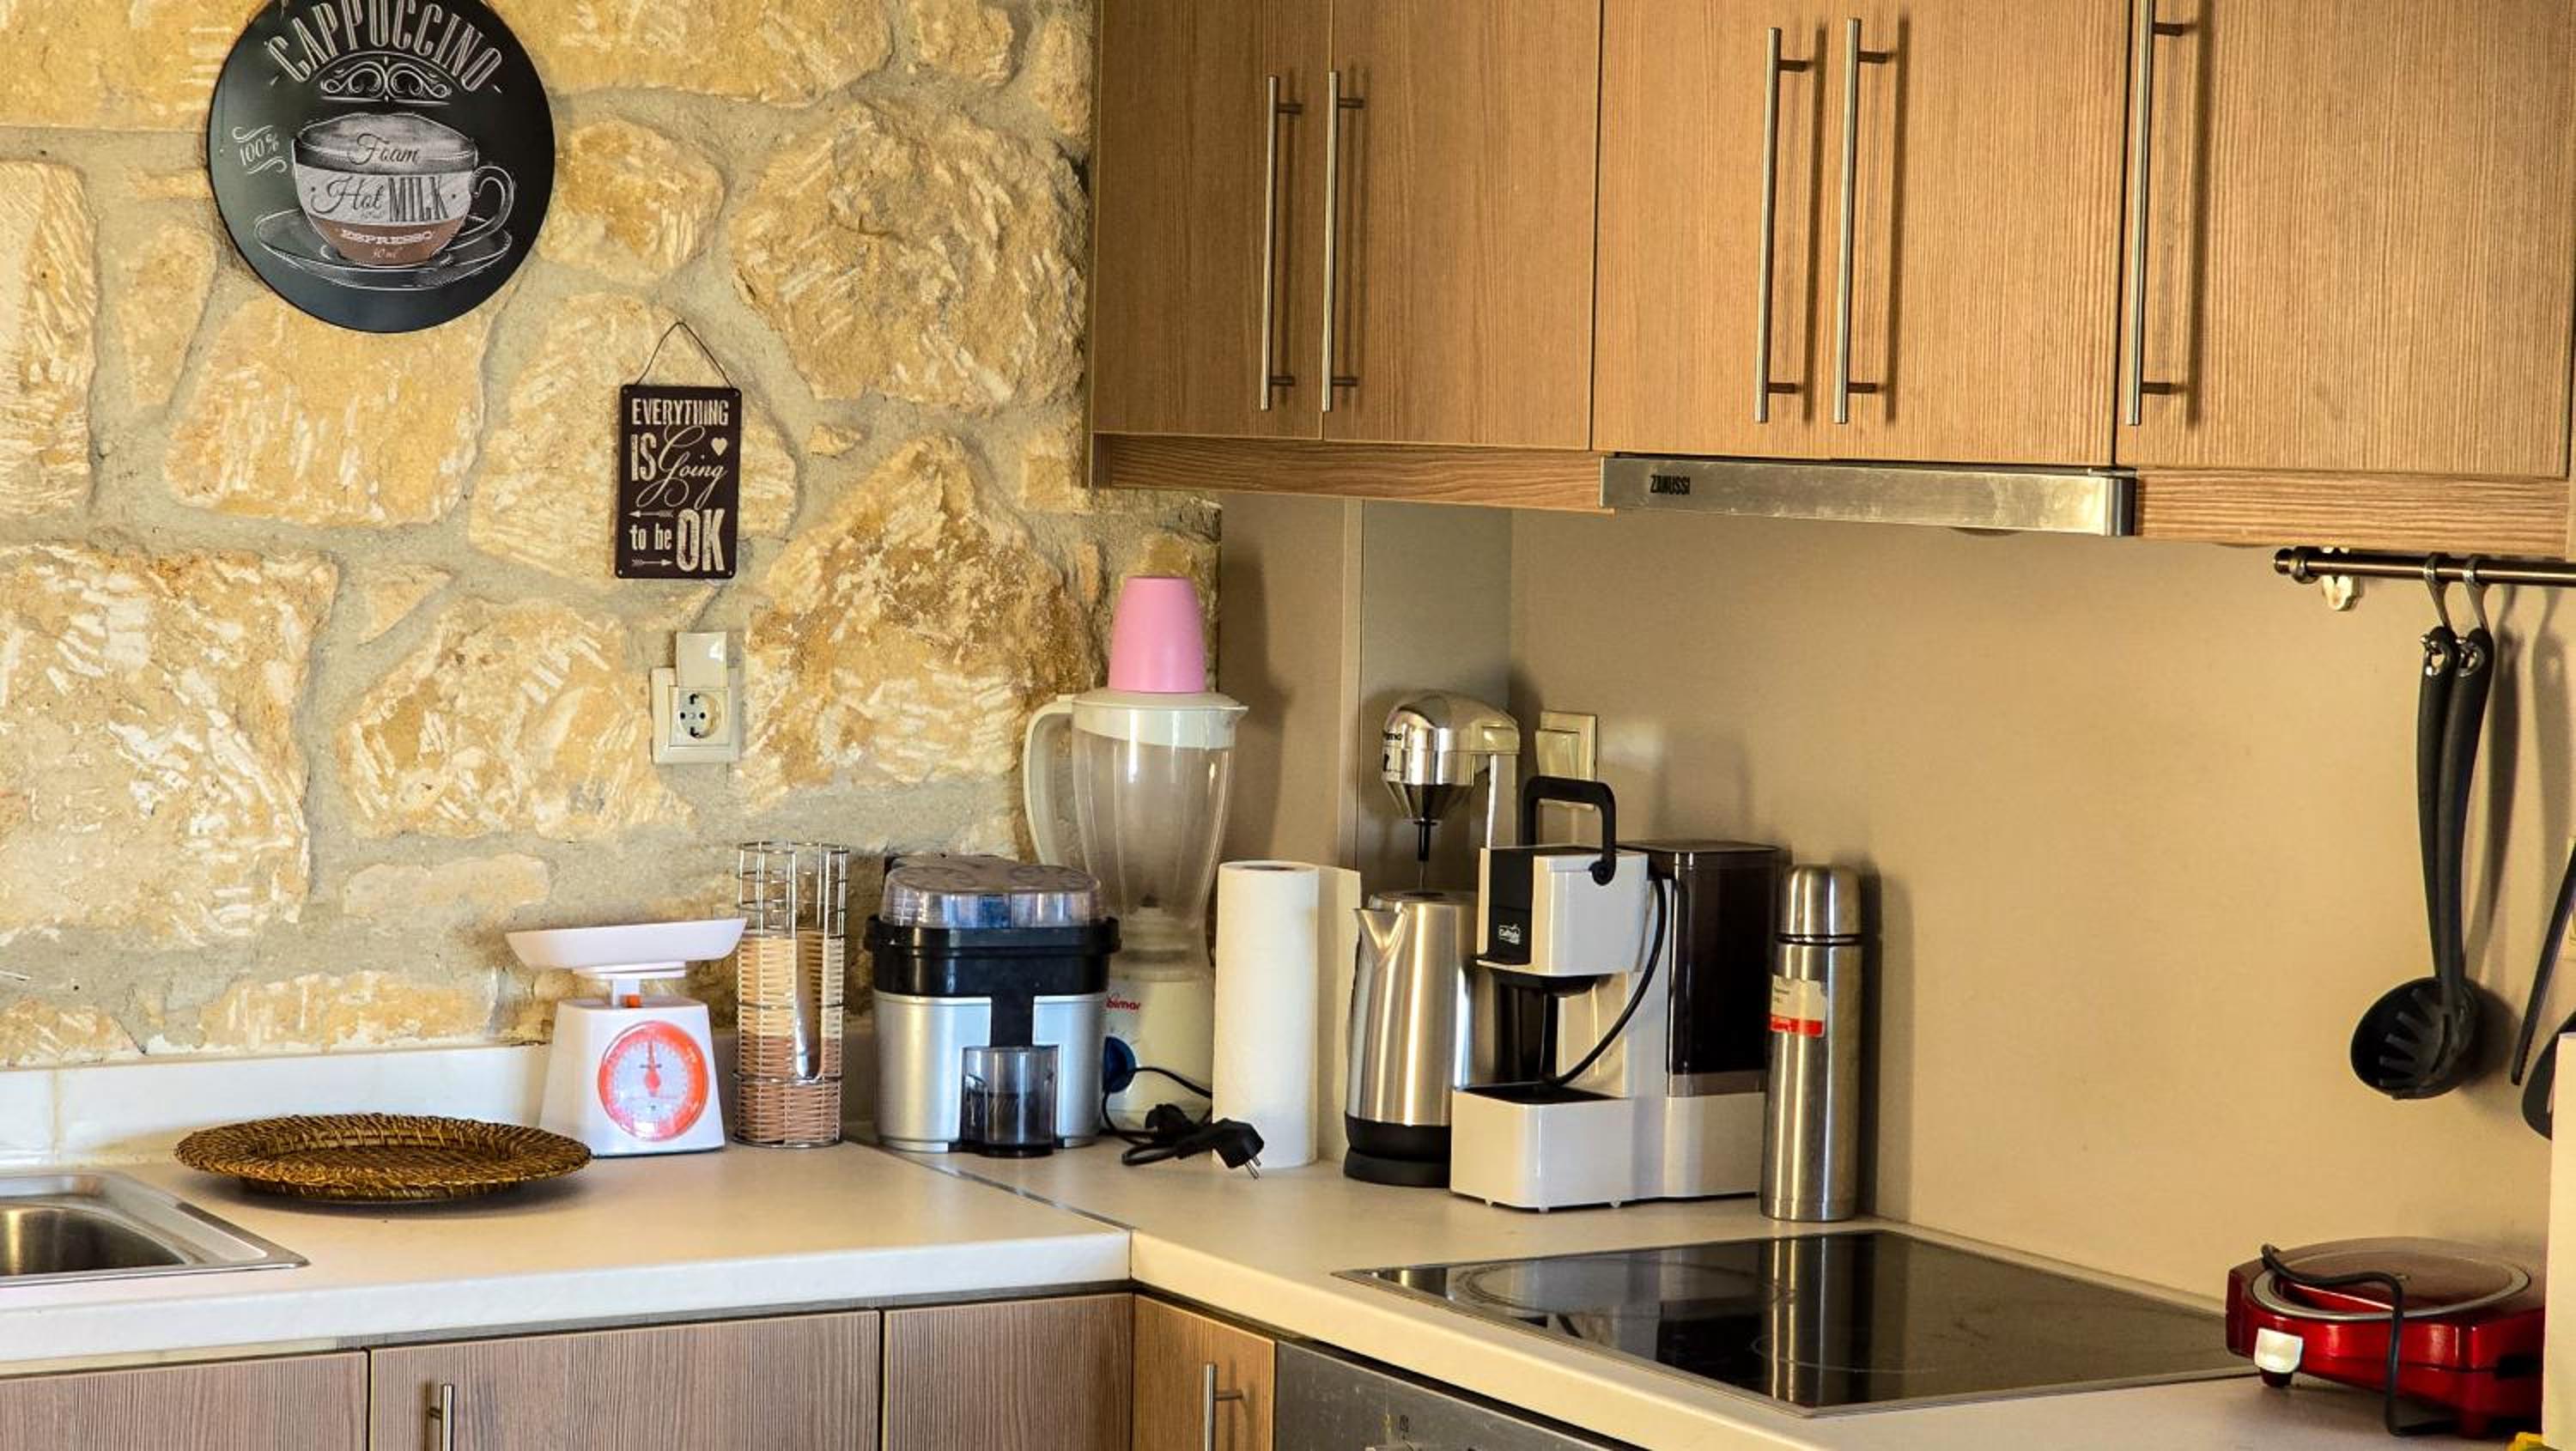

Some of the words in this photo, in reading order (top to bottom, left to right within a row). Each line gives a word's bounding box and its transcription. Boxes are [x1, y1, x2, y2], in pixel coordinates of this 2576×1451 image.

[265, 0, 501, 92] CAPPUCCINO
[240, 133, 279, 166] 100%
[348, 133, 420, 165] Foam
[311, 174, 384, 215] Hot
[388, 175, 448, 222] MILK
[340, 227, 434, 246] ESPRESSO
[631, 398, 729, 426] EVERYTHING
[630, 432, 657, 482] IS
[636, 425, 728, 510] Going
[1649, 475, 1691, 495] ZANUSSI
[629, 524, 647, 550] to
[654, 523, 672, 550] be
[676, 508, 726, 572] OK
